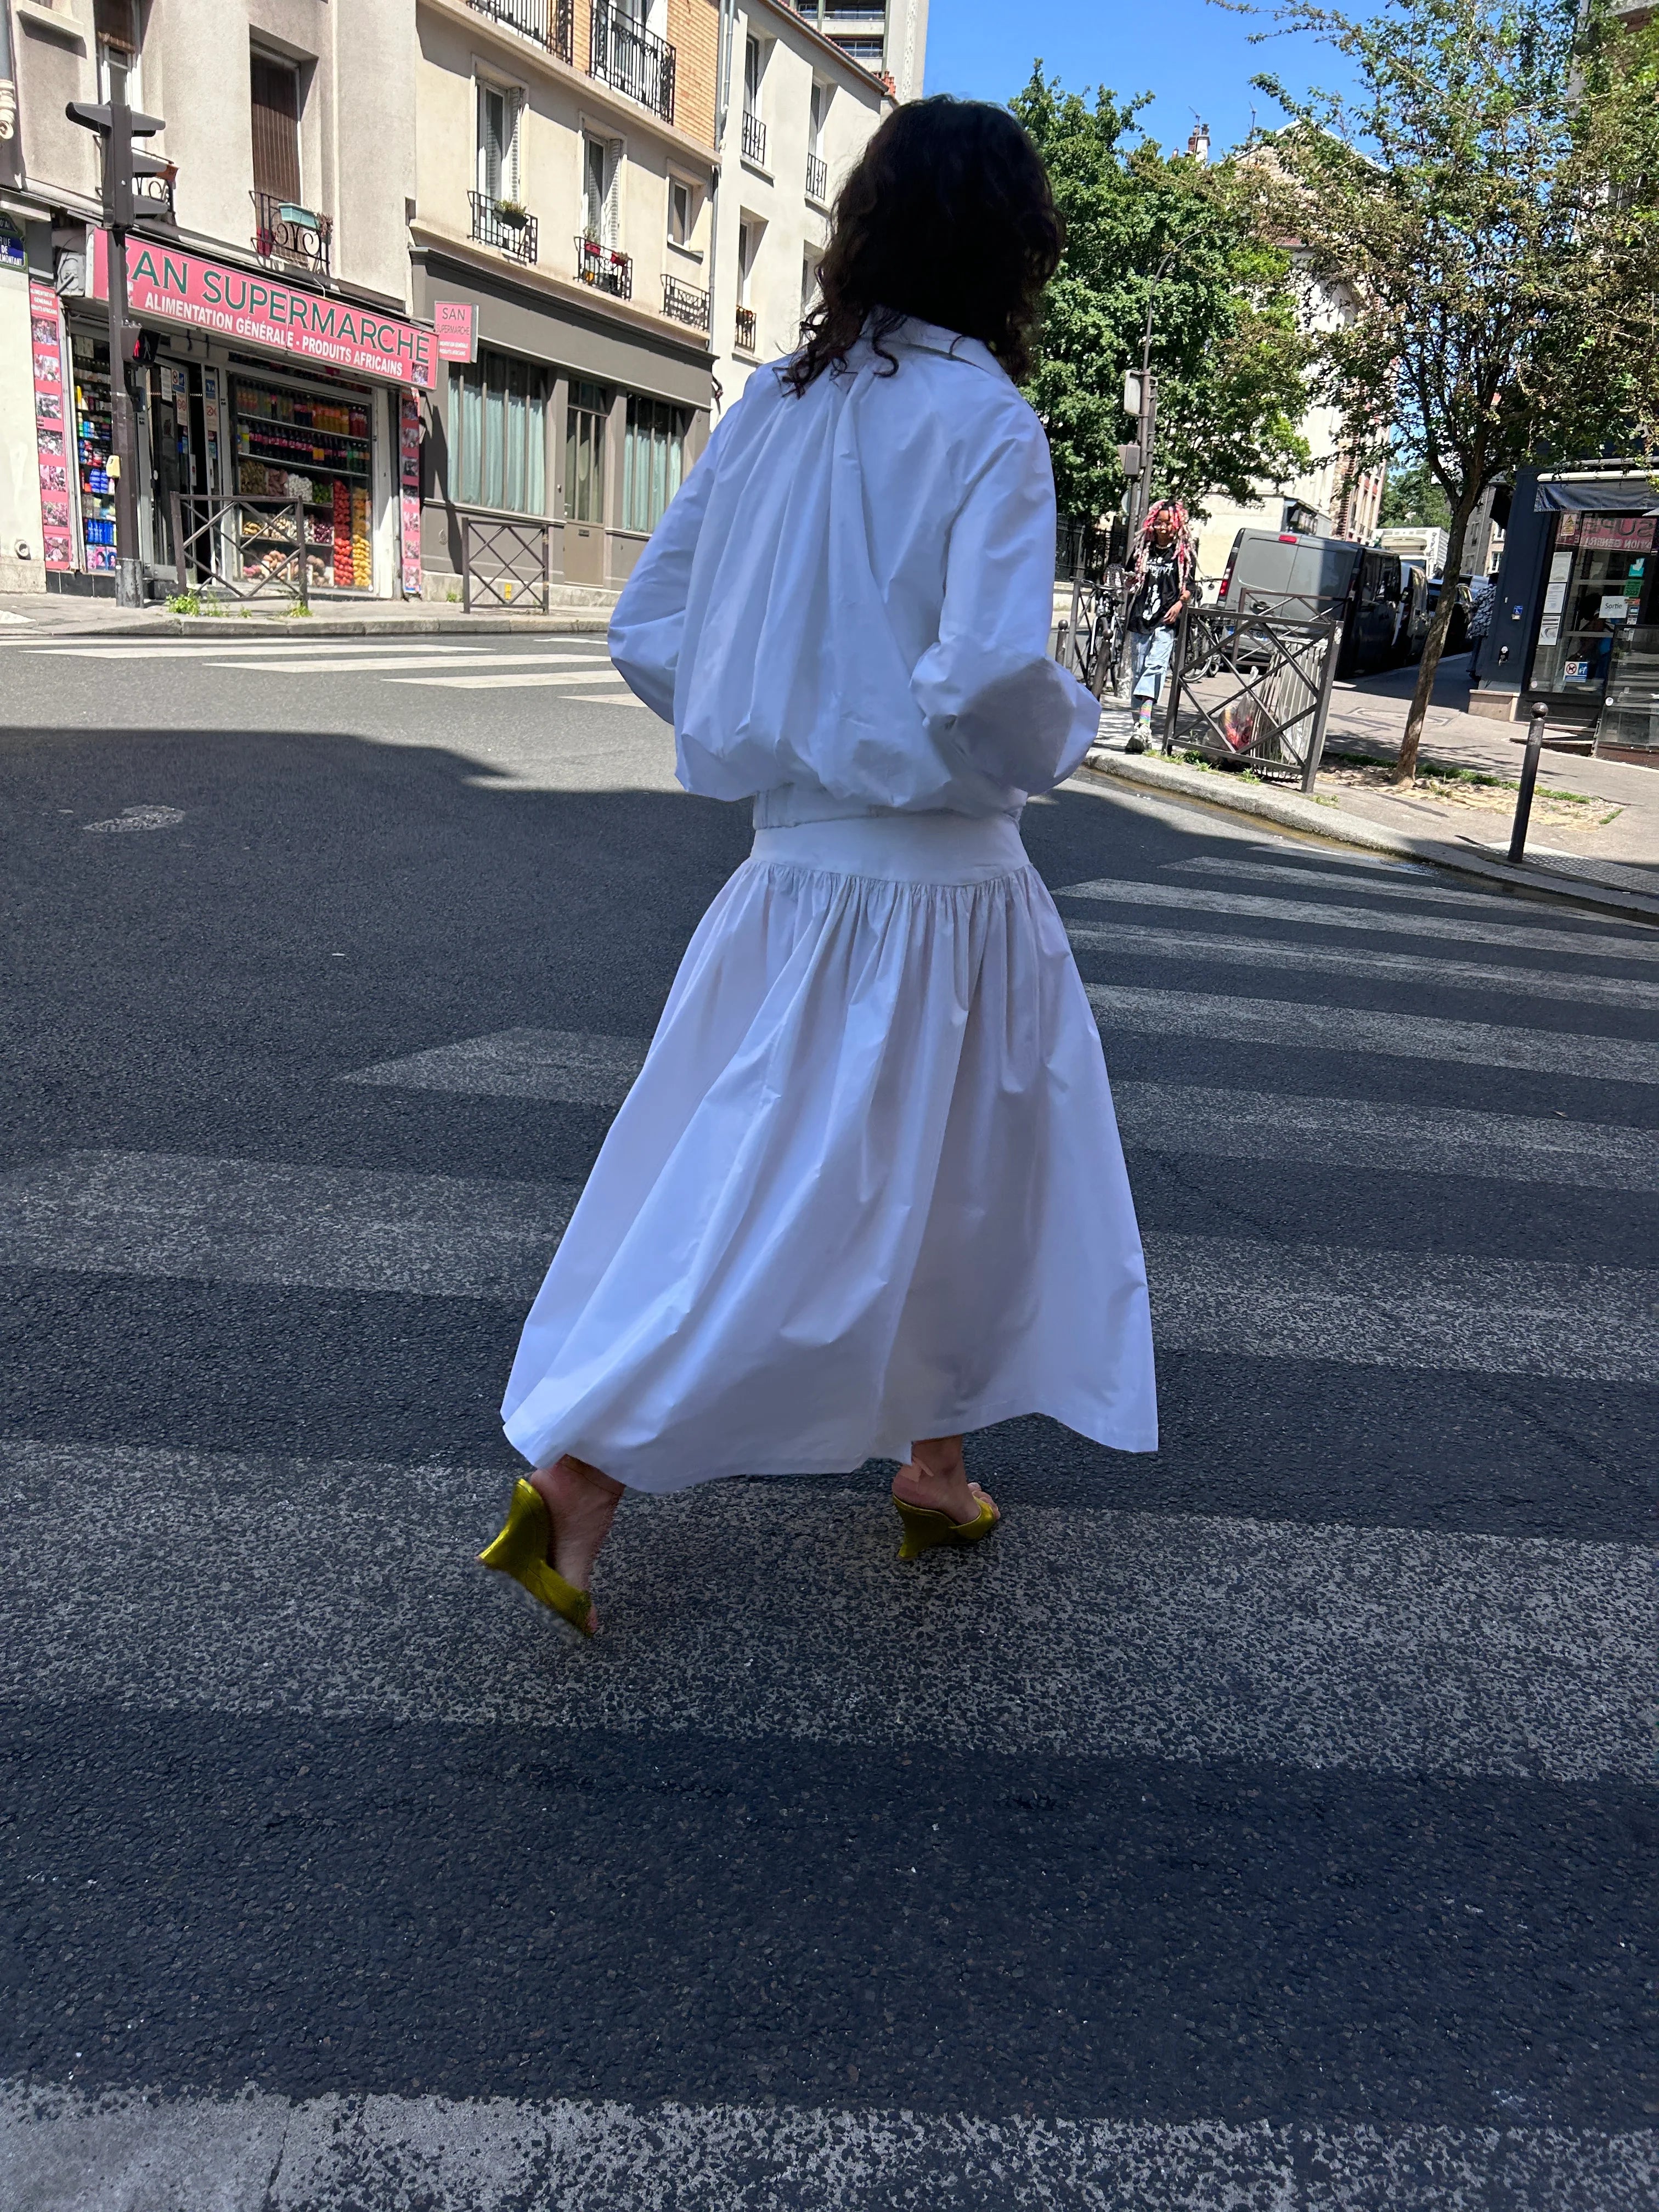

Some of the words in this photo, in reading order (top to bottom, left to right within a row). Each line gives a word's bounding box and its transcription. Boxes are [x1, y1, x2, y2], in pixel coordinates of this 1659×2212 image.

[1, 245, 8, 254] DE
[125, 246, 188, 294] AN
[202, 269, 429, 364] SUPERMARCHÉ
[442, 308, 465, 321] SAN
[144, 292, 233, 331] ALIMENTATION
[236, 315, 294, 347] GÉNÉRALE
[302, 335, 352, 364] PRODUITS
[353, 351, 403, 377] AFRICAINS
